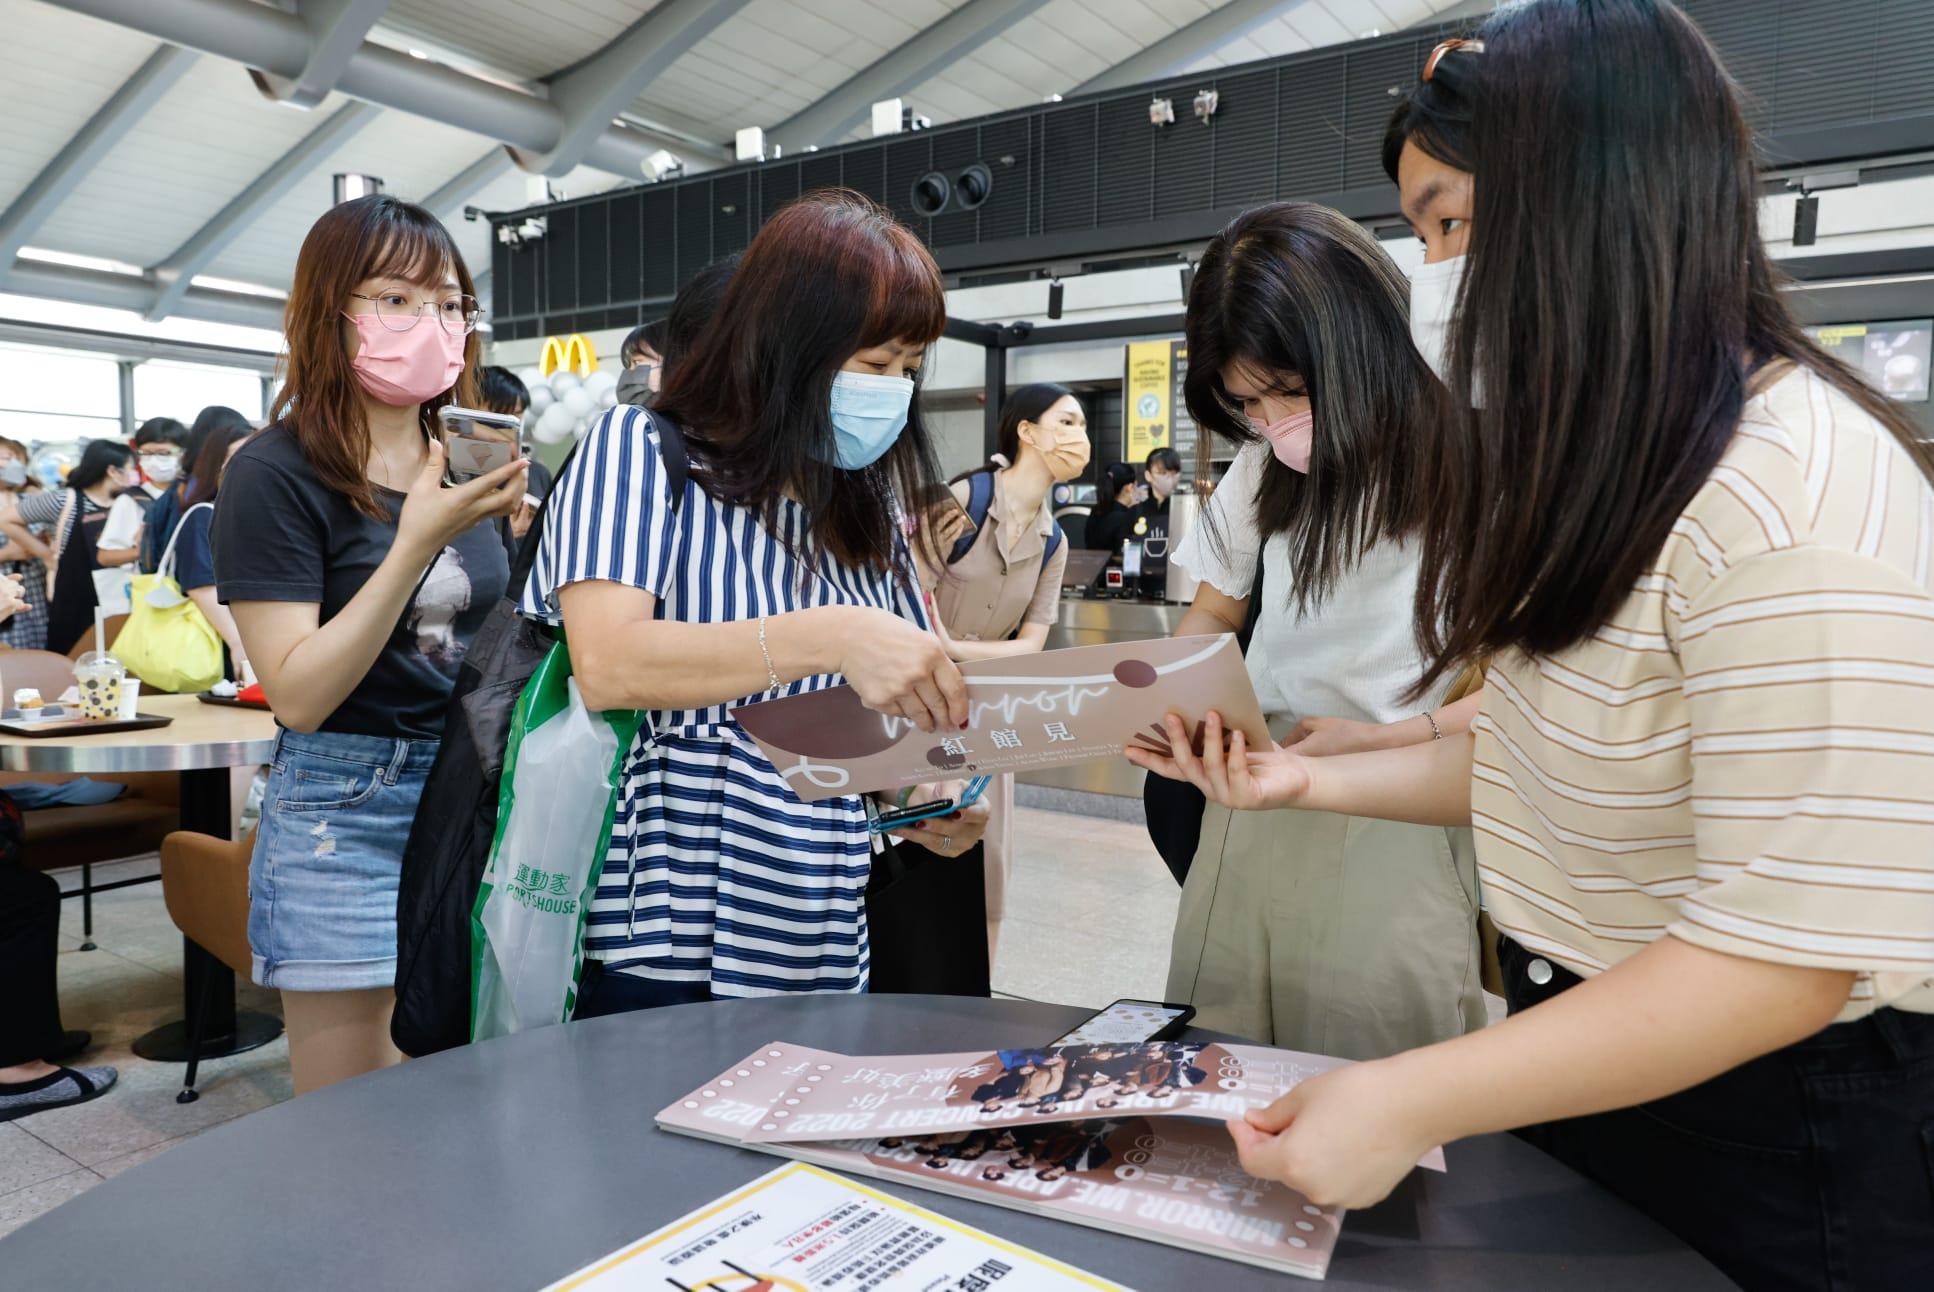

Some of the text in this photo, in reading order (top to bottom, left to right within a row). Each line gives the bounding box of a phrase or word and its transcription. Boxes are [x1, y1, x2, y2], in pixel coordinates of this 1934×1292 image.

[941, 721, 1076, 756] 紅館見
[512, 863, 572, 896] 運動家
[703, 1099, 769, 1126] 022
[785, 1112, 876, 1134] 2022
[944, 1258, 1013, 1292] 呢度
